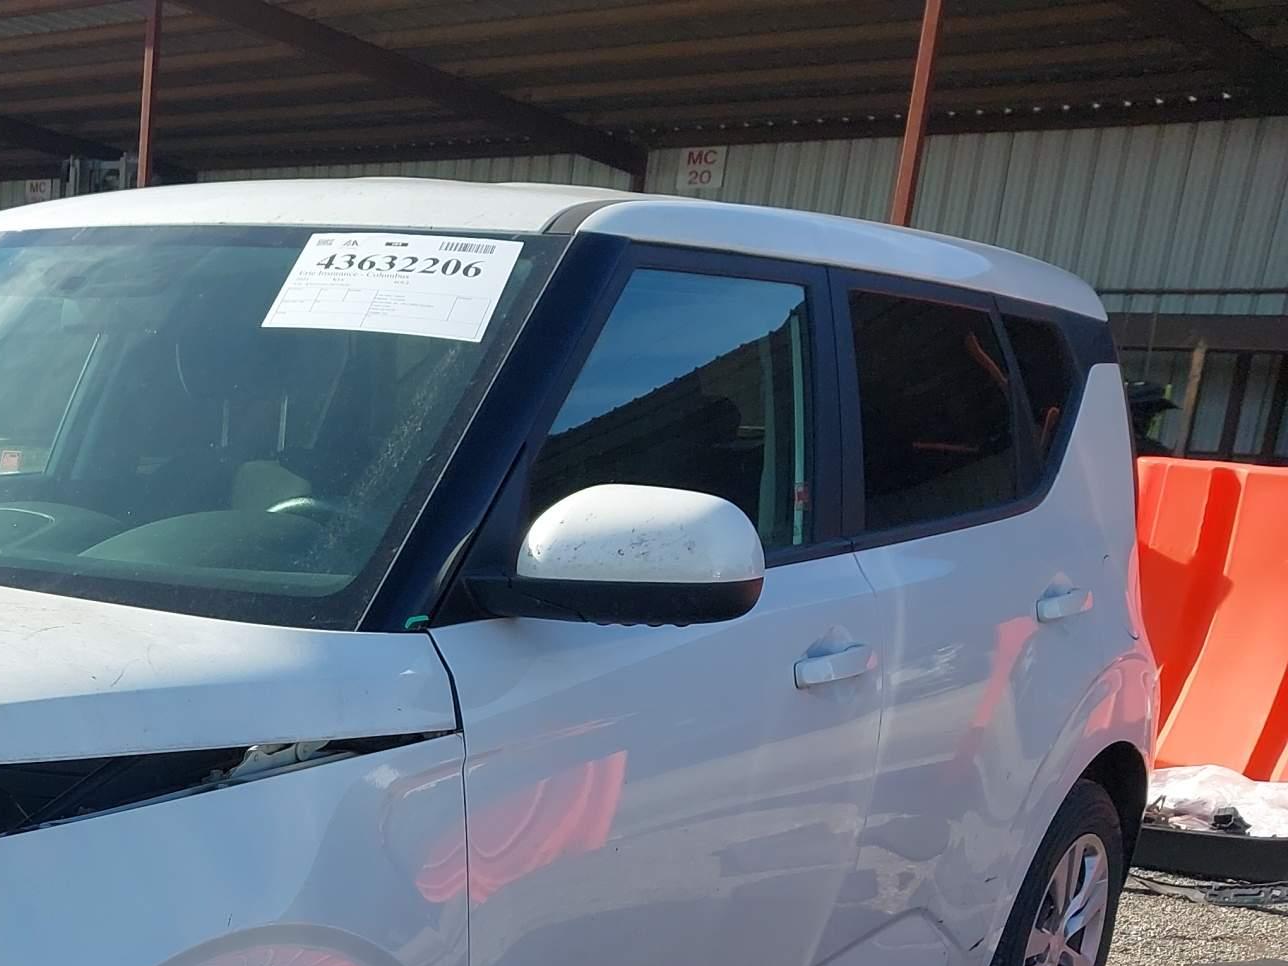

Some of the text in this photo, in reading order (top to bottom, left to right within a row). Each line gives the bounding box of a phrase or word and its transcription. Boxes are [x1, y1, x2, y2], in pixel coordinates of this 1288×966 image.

[687, 150, 717, 165] MC
[687, 170, 712, 185] 20
[316, 253, 485, 277] 43632206
